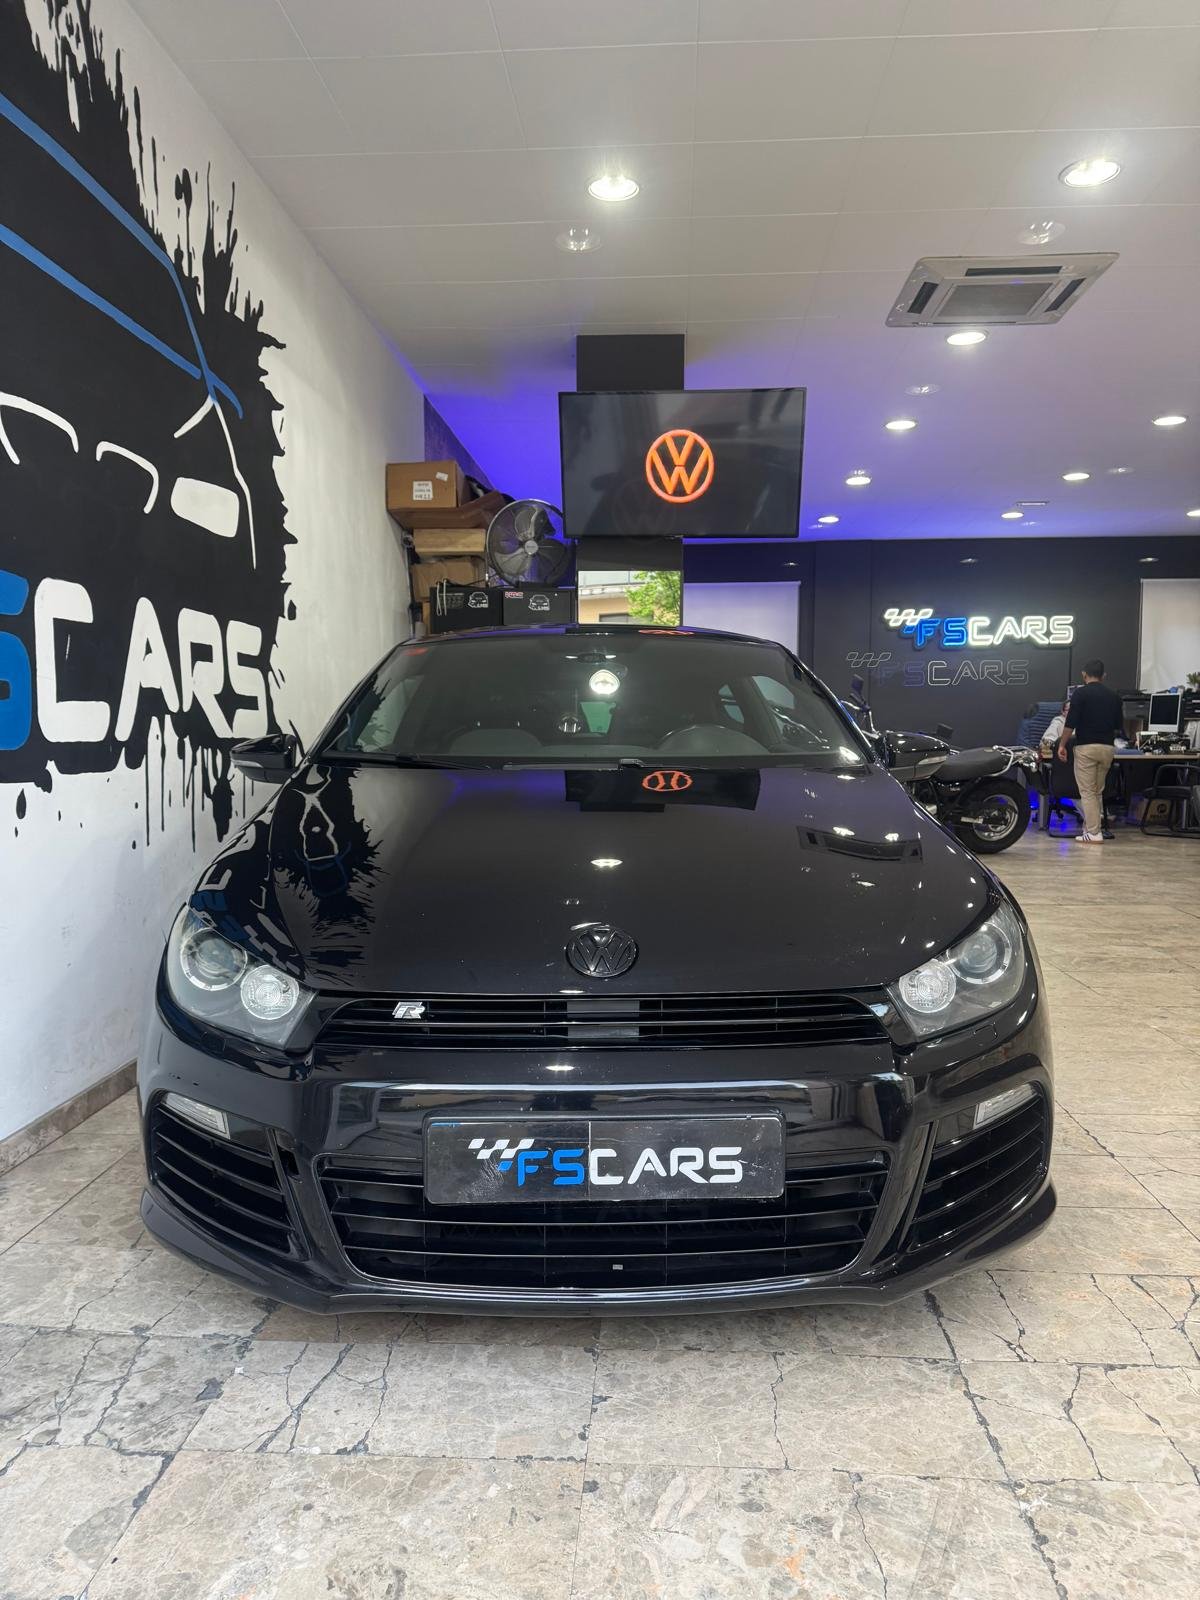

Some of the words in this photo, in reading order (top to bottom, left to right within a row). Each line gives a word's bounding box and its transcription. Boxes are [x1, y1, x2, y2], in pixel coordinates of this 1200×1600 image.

[648, 431, 712, 499] VW
[904, 615, 1074, 647] FSCARS
[568, 927, 637, 977] VW
[392, 1001, 426, 1019] R
[499, 1147, 743, 1187] FSCARS
